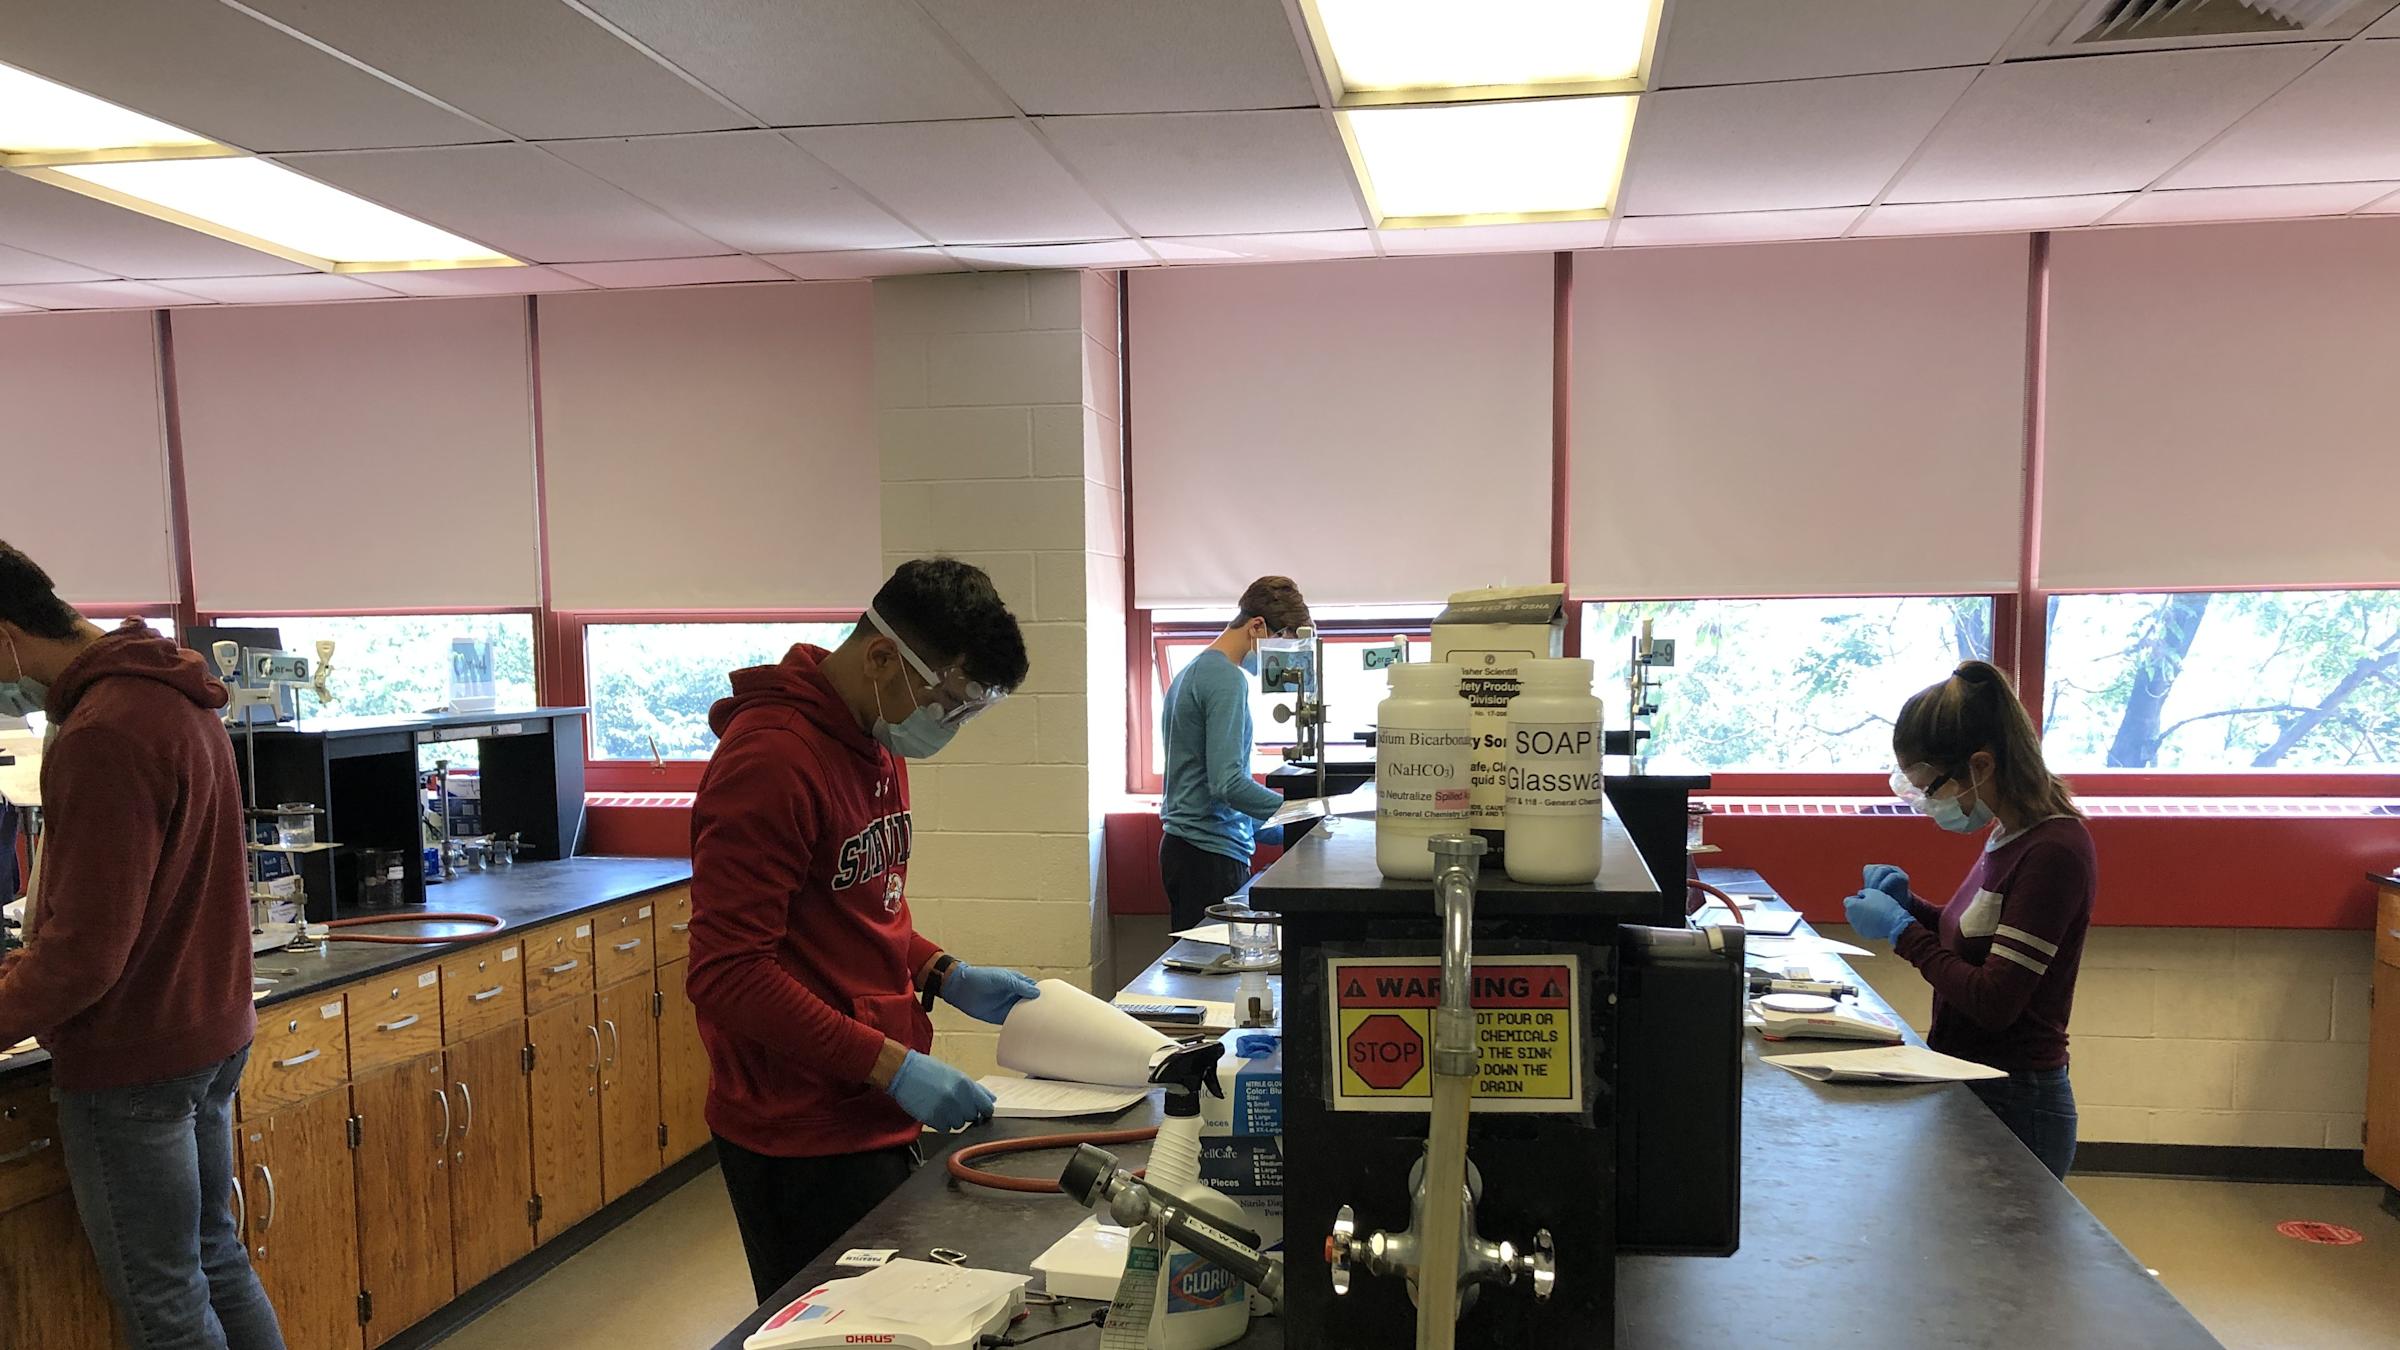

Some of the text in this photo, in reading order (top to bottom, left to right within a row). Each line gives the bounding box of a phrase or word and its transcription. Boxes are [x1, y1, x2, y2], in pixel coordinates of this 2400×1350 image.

[1462, 667, 1518, 676] isher Scientifi
[1461, 681, 1520, 693] fety Produc
[1469, 694, 1510, 704] Division
[1516, 730, 1591, 755] SOAP
[1470, 762, 1490, 773] afe,
[1471, 775, 1495, 788] quid
[1507, 766, 1600, 792] Glasswa
[1386, 790, 1432, 801] Neutralize
[1435, 791, 1463, 803] Spilled
[1544, 799, 1577, 807] General
[1376, 977, 1530, 998] WARING
[1477, 1013, 1553, 1024] OT POUR OR
[1481, 1030, 1558, 1042] CHEMICALS
[1354, 1042, 1417, 1063] STOP
[1488, 1047, 1513, 1058] THE
[1517, 1047, 1552, 1059] SINK
[1484, 1064, 1518, 1076] DOWN
[1523, 1064, 1548, 1076] THE
[1246, 1087, 1282, 1095] Color: Blu
[1480, 1080, 1523, 1092] DRAIN
[1206, 1119, 1229, 1127] ieces
[1199, 1147, 1238, 1159] ellCare
[1210, 1178, 1239, 1187] Pieces
[1189, 1219, 1258, 1257] EYEWASH
